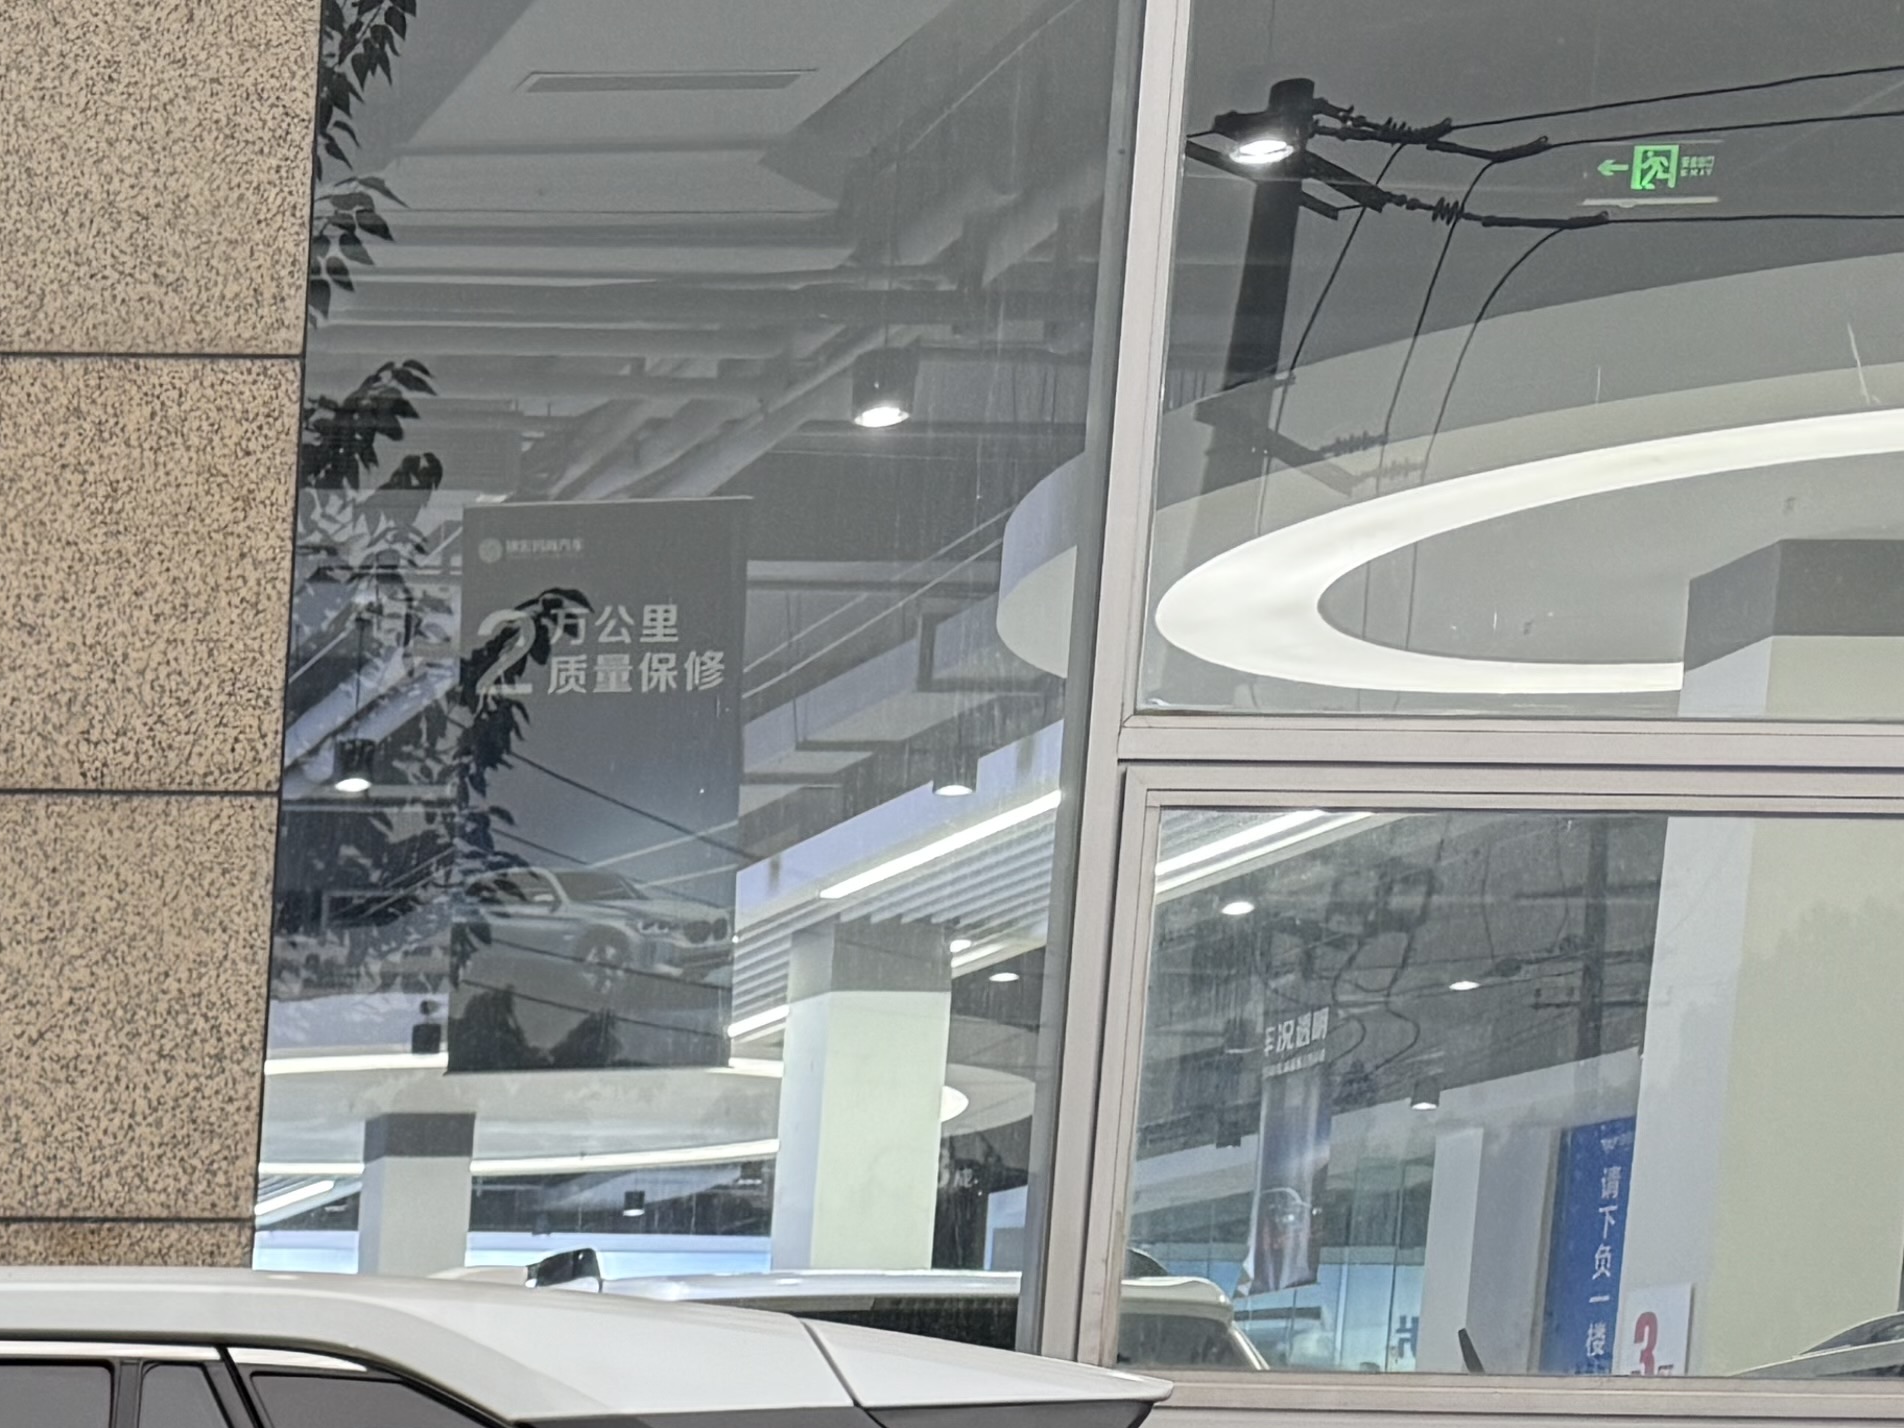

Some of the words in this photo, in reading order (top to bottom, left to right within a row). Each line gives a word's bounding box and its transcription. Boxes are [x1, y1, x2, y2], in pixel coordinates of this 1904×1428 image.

[544, 605, 679, 645] 万公里
[547, 650, 726, 695] 质量保修
